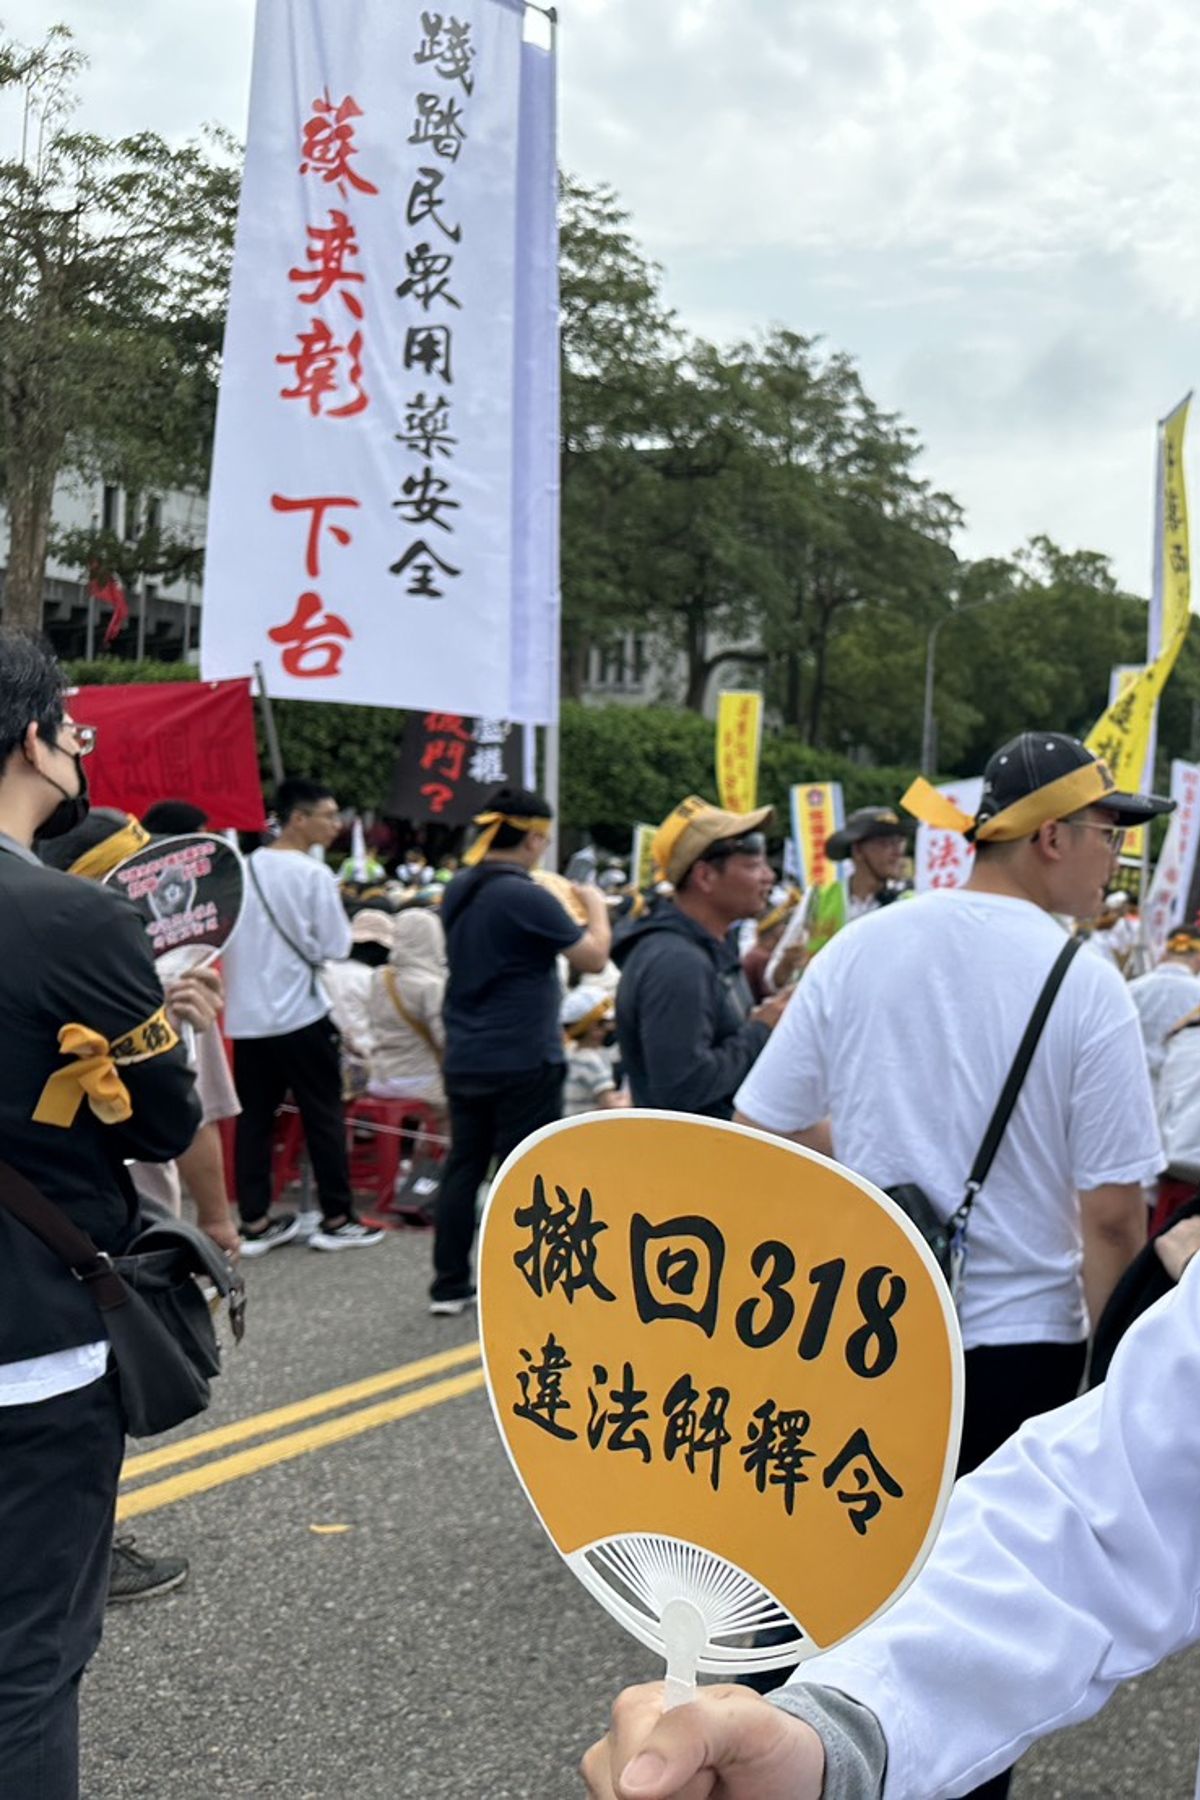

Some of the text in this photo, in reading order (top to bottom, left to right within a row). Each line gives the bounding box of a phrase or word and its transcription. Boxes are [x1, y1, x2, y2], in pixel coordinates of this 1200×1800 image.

[513, 1173, 907, 1379] 撤回318
[513, 1332, 905, 1536] 違法解釋令
